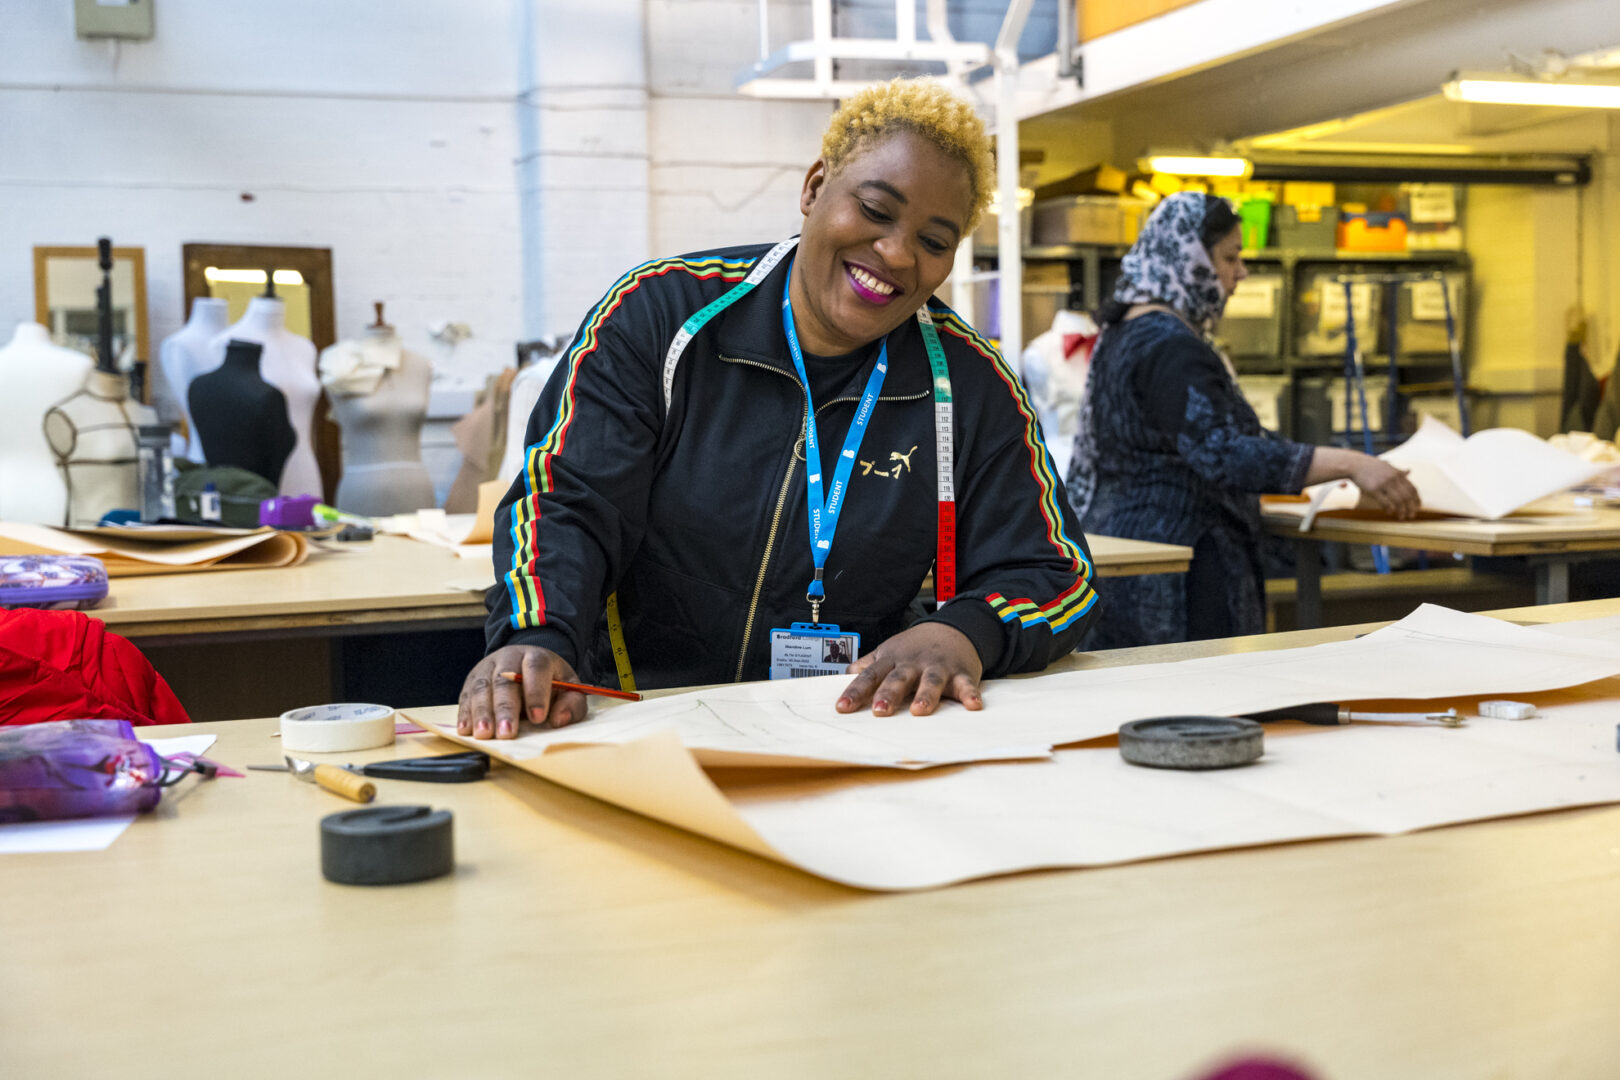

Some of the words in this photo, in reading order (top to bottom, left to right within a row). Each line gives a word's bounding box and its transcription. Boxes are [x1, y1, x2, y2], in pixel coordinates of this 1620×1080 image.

[856, 393, 874, 426] STUDENT
[828, 480, 843, 515] STUDENT
[813, 508, 821, 542] STUDE
